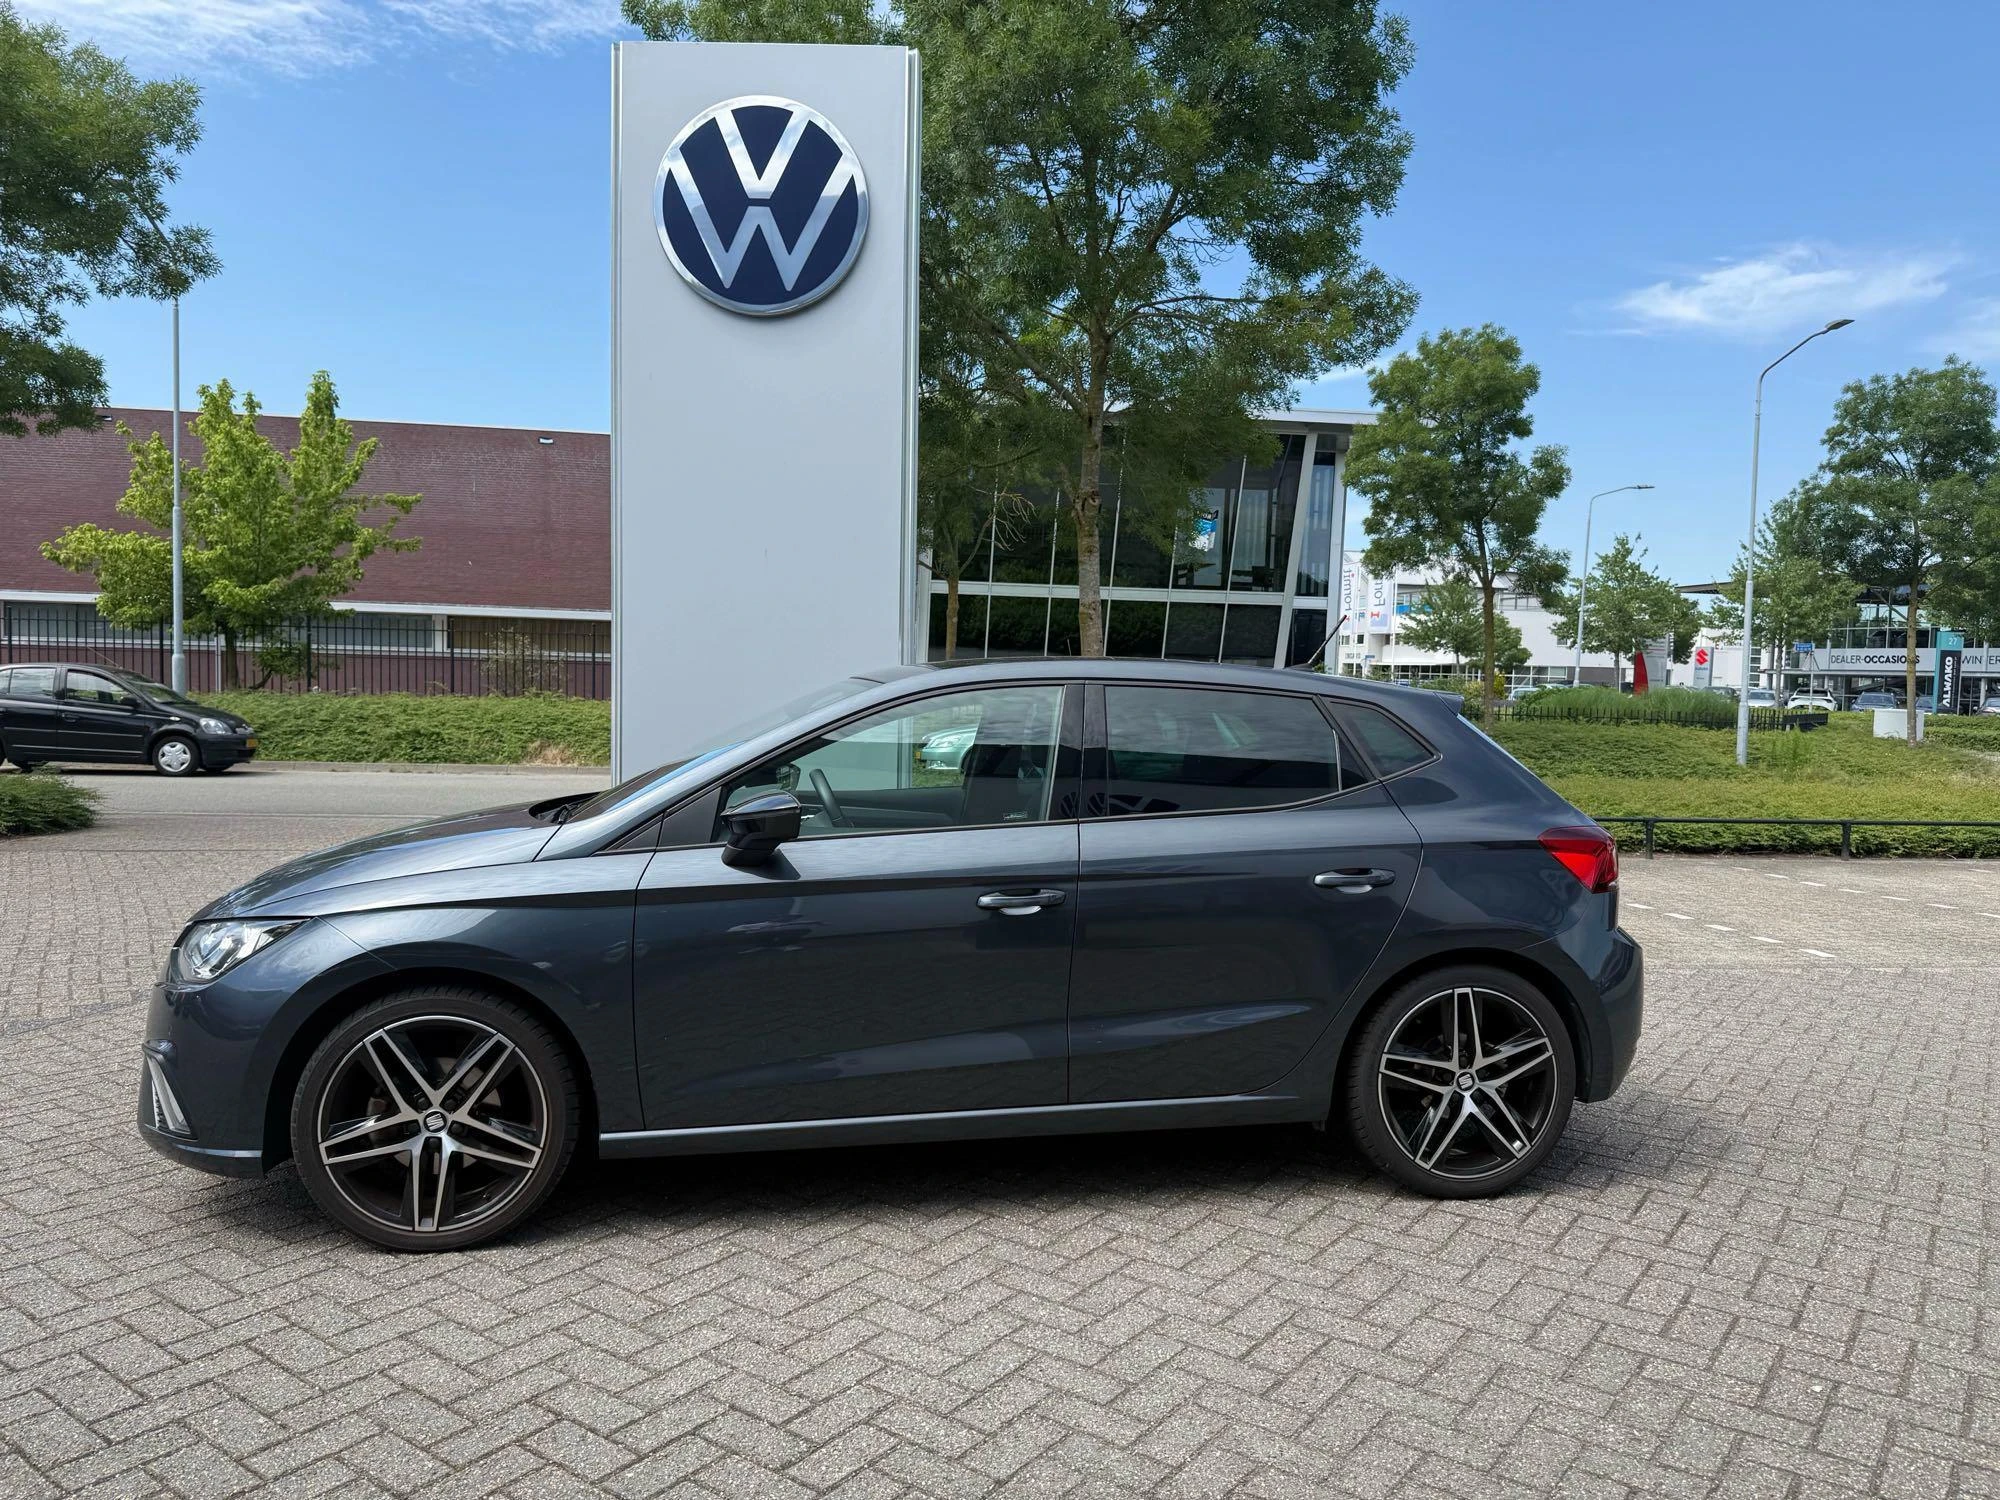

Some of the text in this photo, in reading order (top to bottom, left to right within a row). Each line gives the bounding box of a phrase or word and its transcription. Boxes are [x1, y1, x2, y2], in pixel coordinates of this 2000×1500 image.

[1948, 637, 1958, 645] 27
[1830, 655, 1920, 664] DEALER-OCCASIOS
[1942, 656, 1953, 707] ALWAKO
